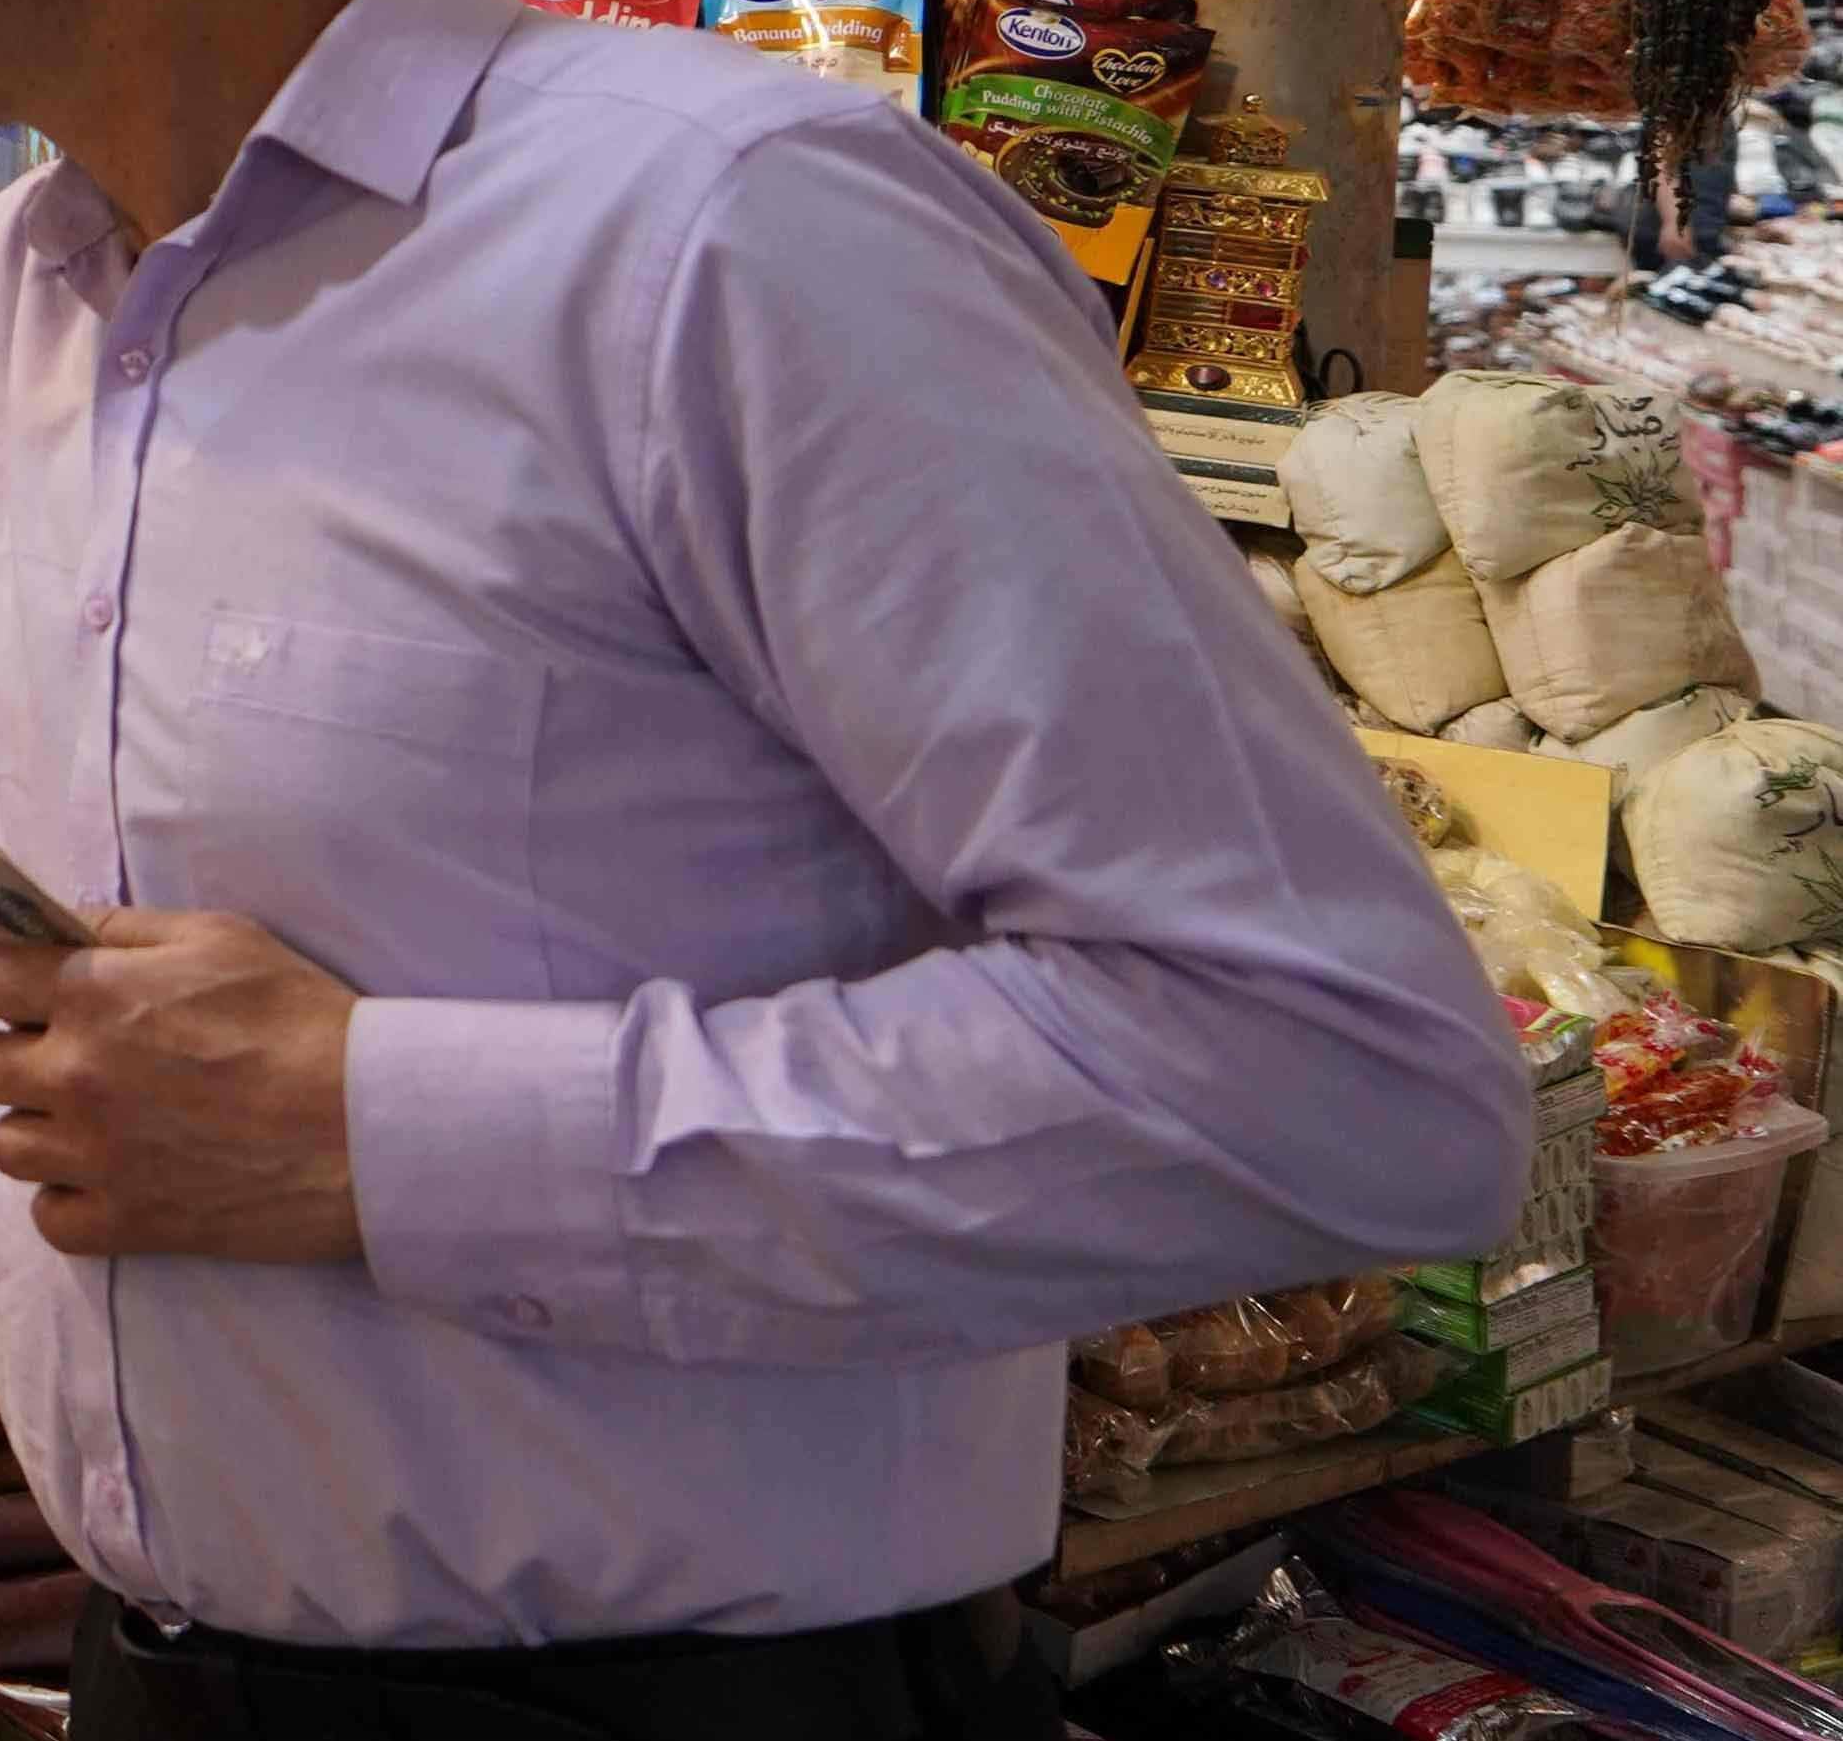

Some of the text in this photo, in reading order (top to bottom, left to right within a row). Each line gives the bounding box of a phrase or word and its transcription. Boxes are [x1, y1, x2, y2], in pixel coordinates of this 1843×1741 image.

[733, 26, 803, 44] Banana
[1009, 18, 1073, 50] Kenton
[1034, 84, 1112, 113] Chocolate
[982, 89, 1043, 116] Pudding
[1046, 101, 1082, 119] with
[1084, 107, 1154, 146] Pistachio
